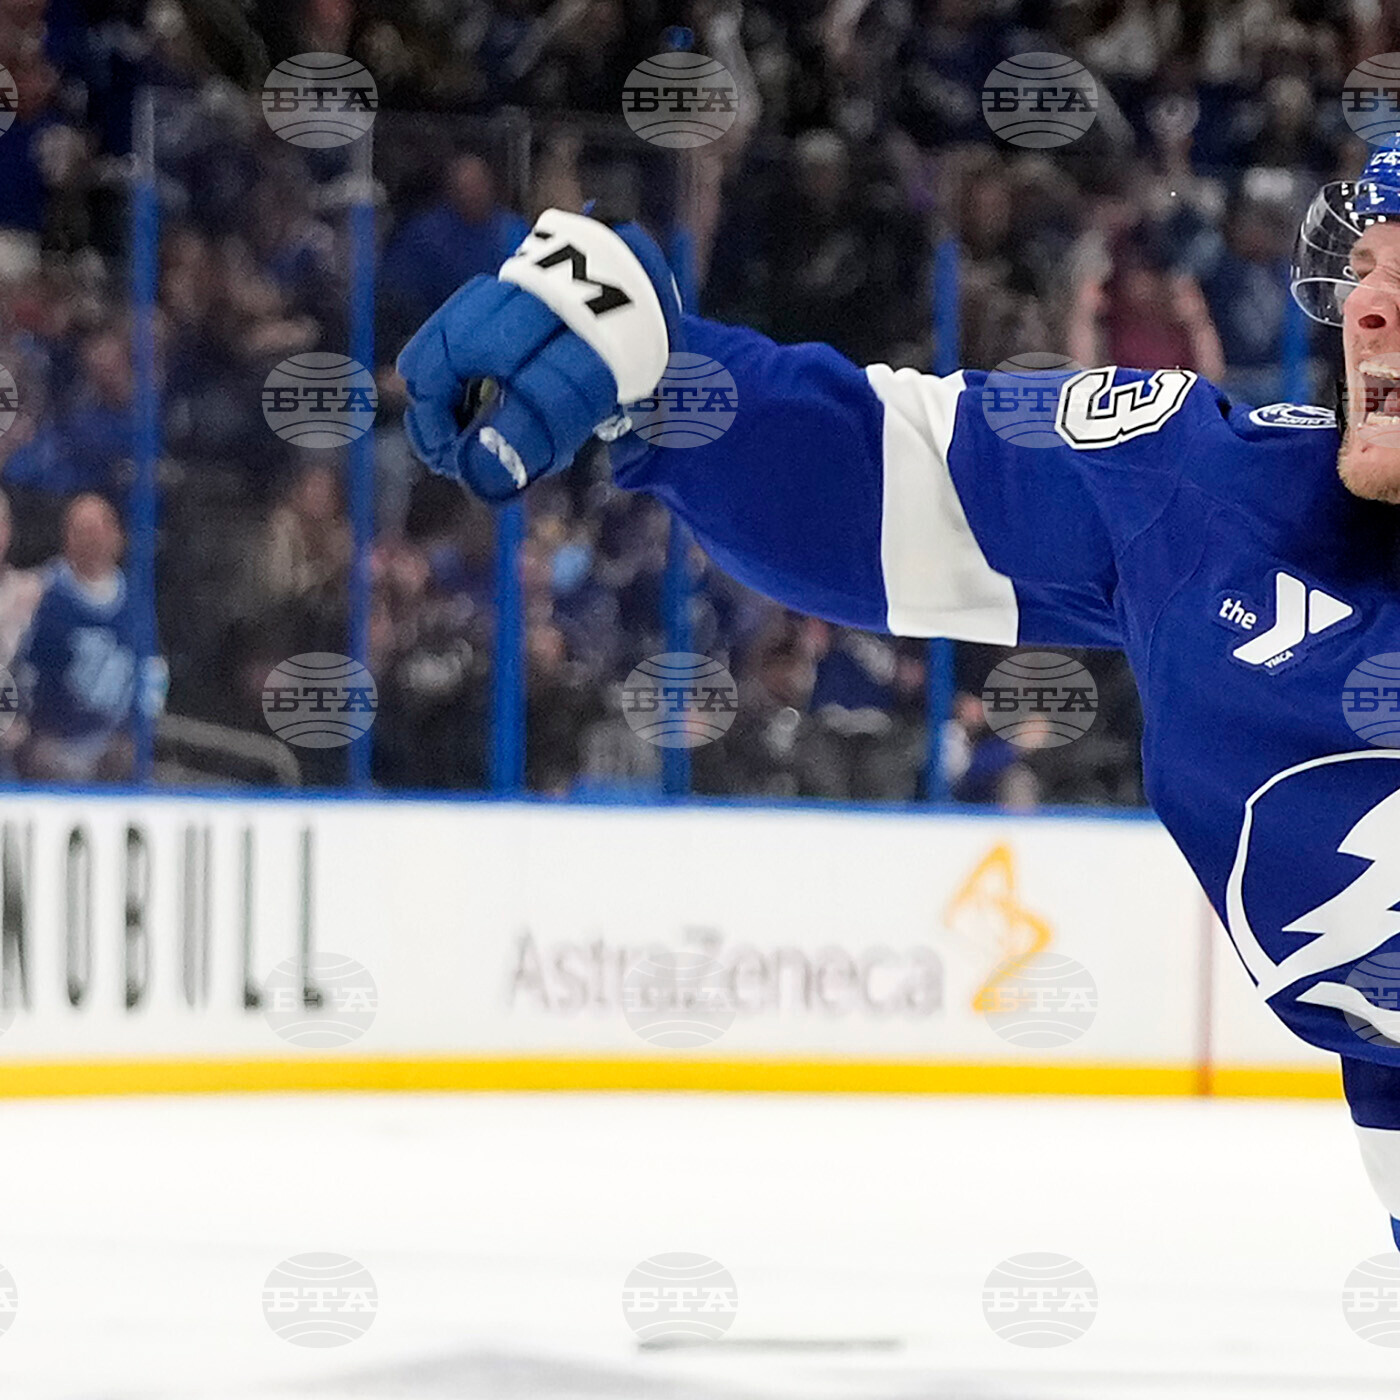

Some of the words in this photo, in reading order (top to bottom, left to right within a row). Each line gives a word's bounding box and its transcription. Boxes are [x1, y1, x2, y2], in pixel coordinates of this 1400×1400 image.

[1219, 598, 1257, 630] the
[1264, 649, 1294, 669] YMCA
[1, 818, 324, 1012] NOBULL
[509, 925, 946, 1014] AstraZeneca
